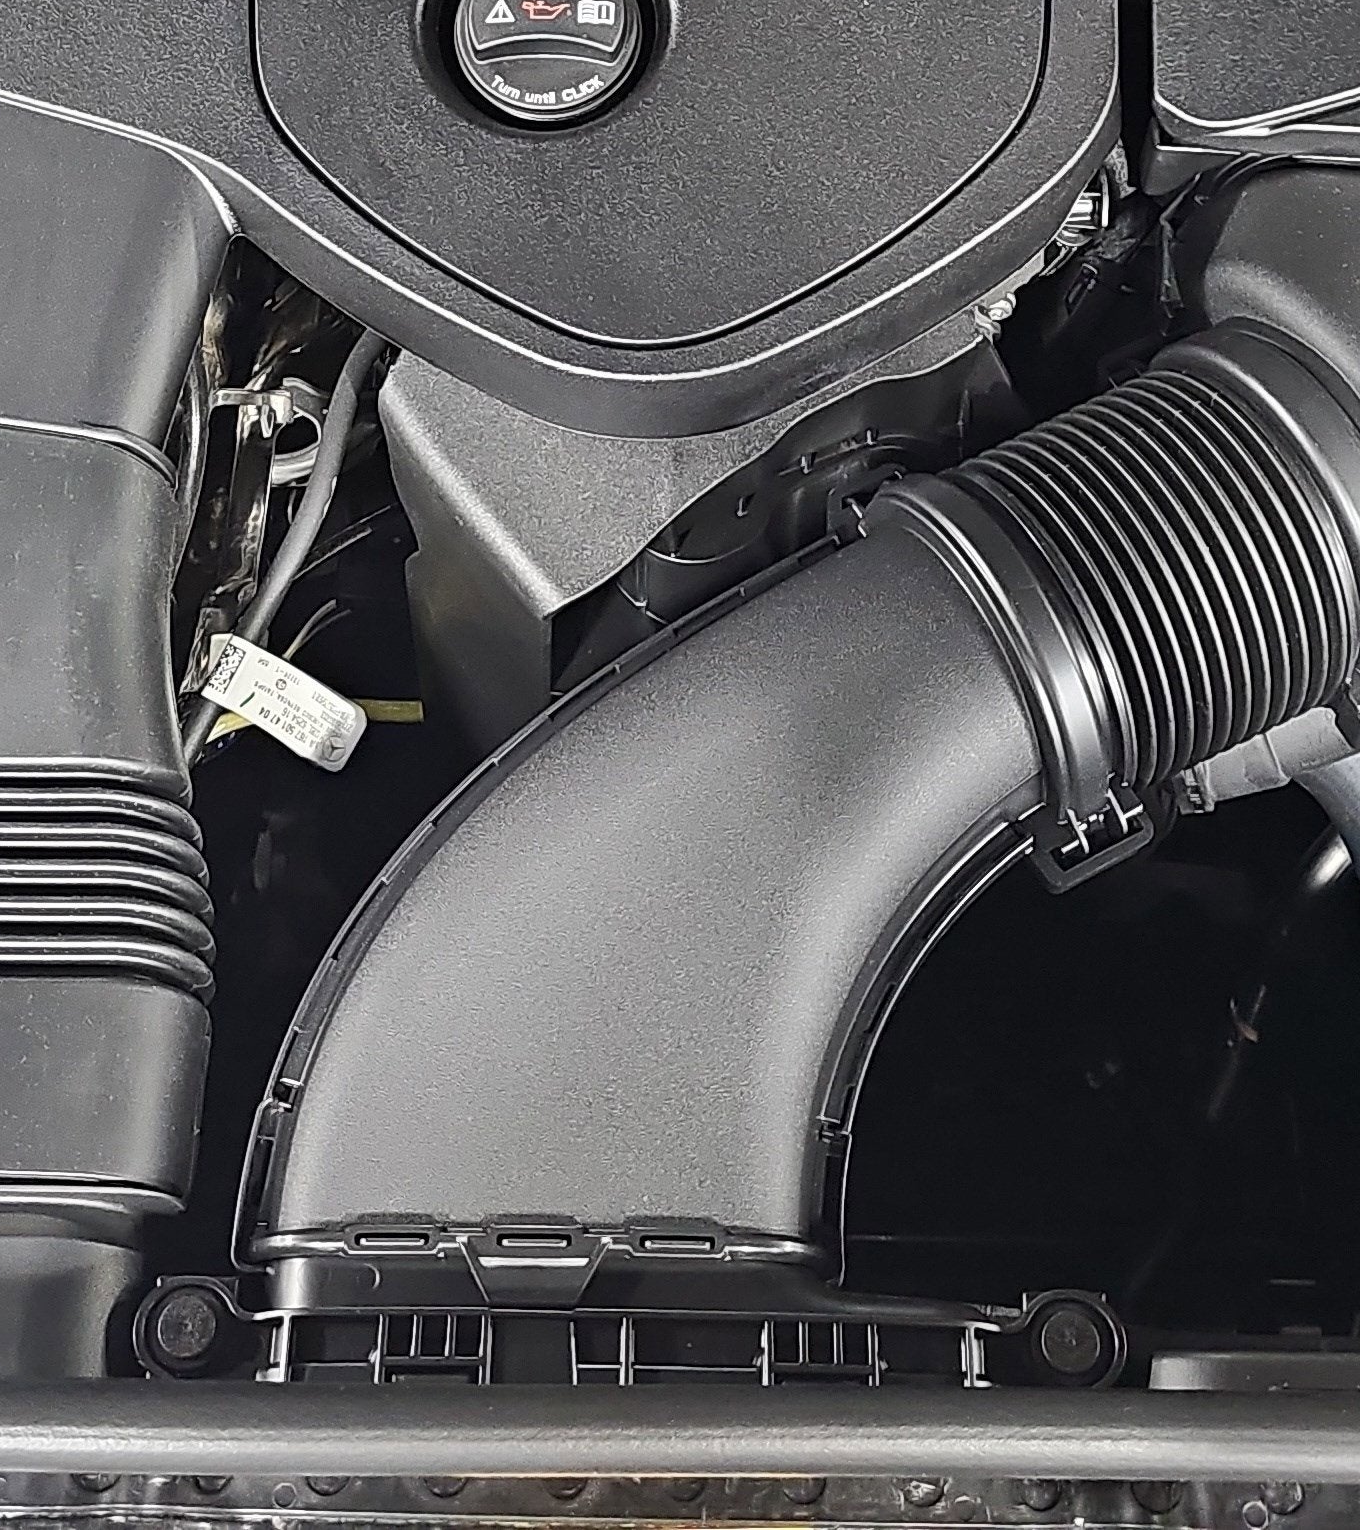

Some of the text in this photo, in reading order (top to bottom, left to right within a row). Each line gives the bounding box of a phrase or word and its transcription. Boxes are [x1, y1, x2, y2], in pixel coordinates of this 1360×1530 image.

[491, 74, 605, 105] Turn until CLICK
[258, 707, 270, 719] 04
[279, 720, 296, 735] 501
